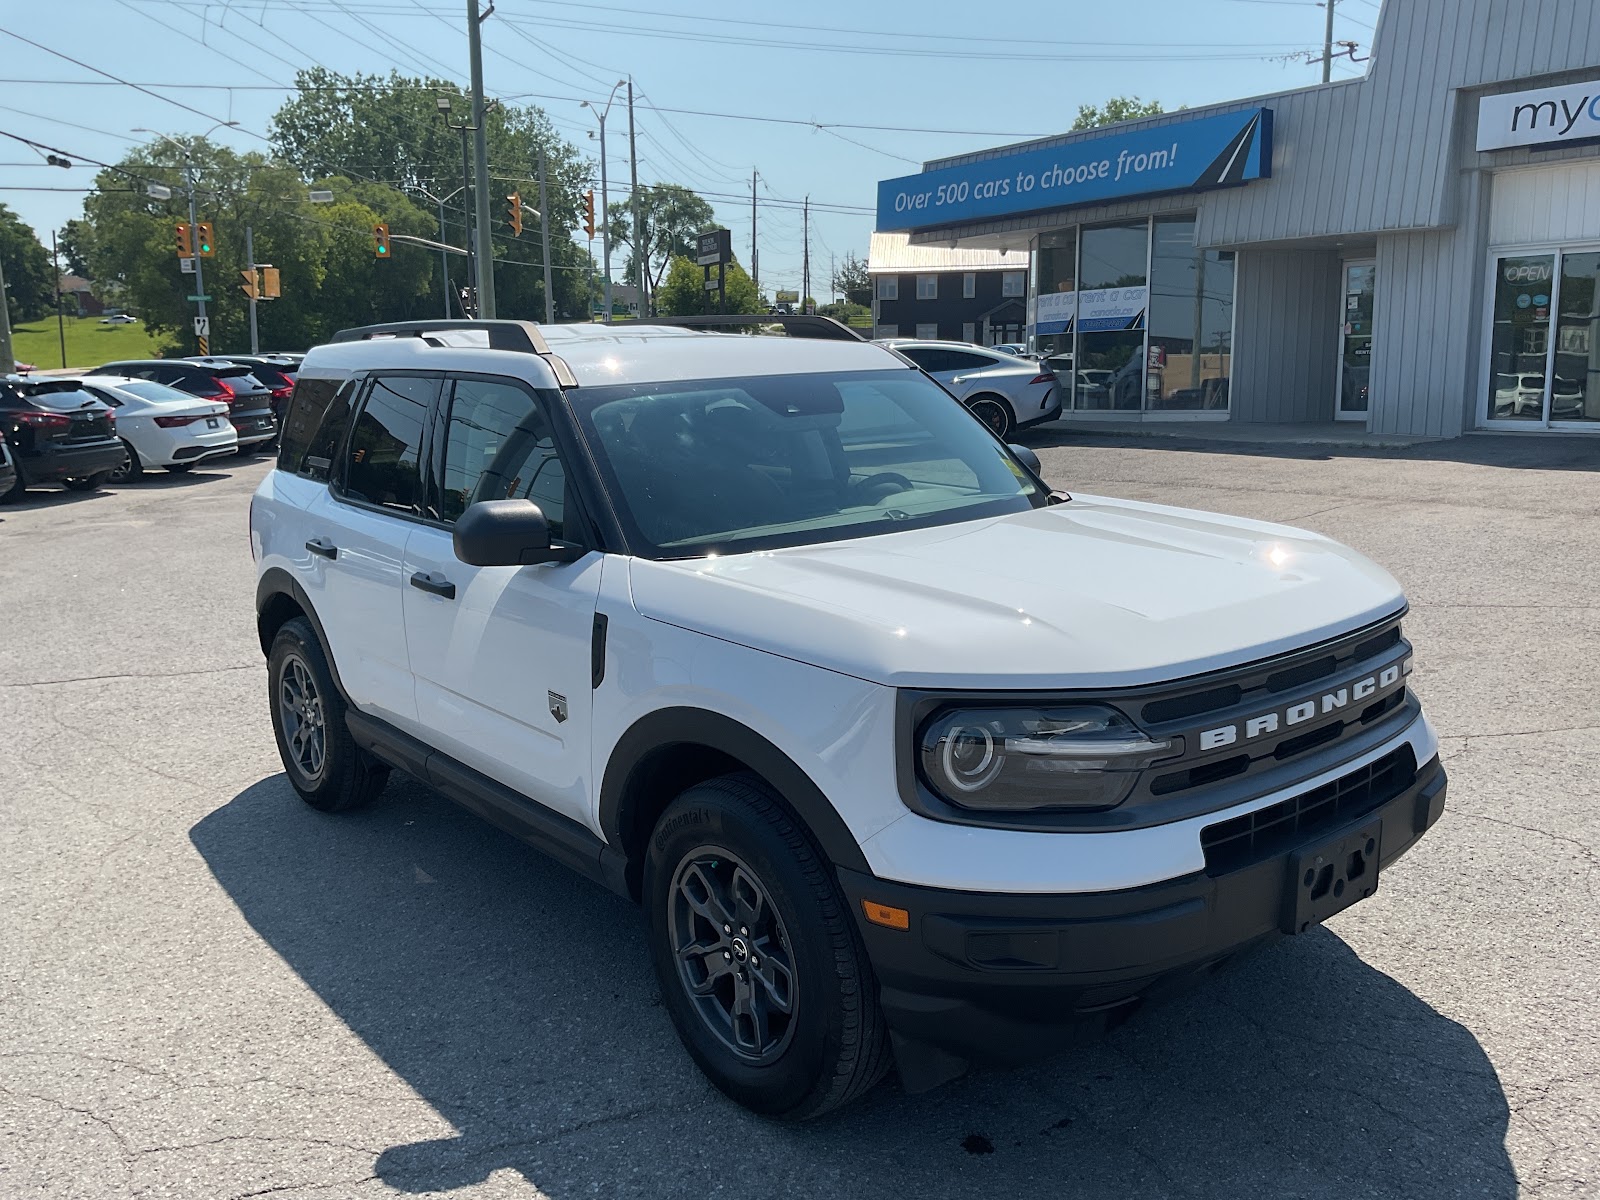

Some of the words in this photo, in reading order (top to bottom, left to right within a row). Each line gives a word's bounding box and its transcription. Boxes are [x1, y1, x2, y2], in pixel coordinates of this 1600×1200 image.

[894, 191, 933, 212] Over
[935, 181, 969, 206] 500
[973, 178, 1011, 200] cars
[1016, 171, 1035, 193] to
[1040, 160, 1110, 189] choose
[1114, 143, 1178, 182] from!
[1506, 265, 1551, 281] OPEN
[1079, 288, 1107, 304] rent
[1109, 290, 1120, 302] a
[1123, 288, 1147, 302] car
[1199, 665, 1399, 751] BRONCO
[655, 808, 702, 851] Continental
